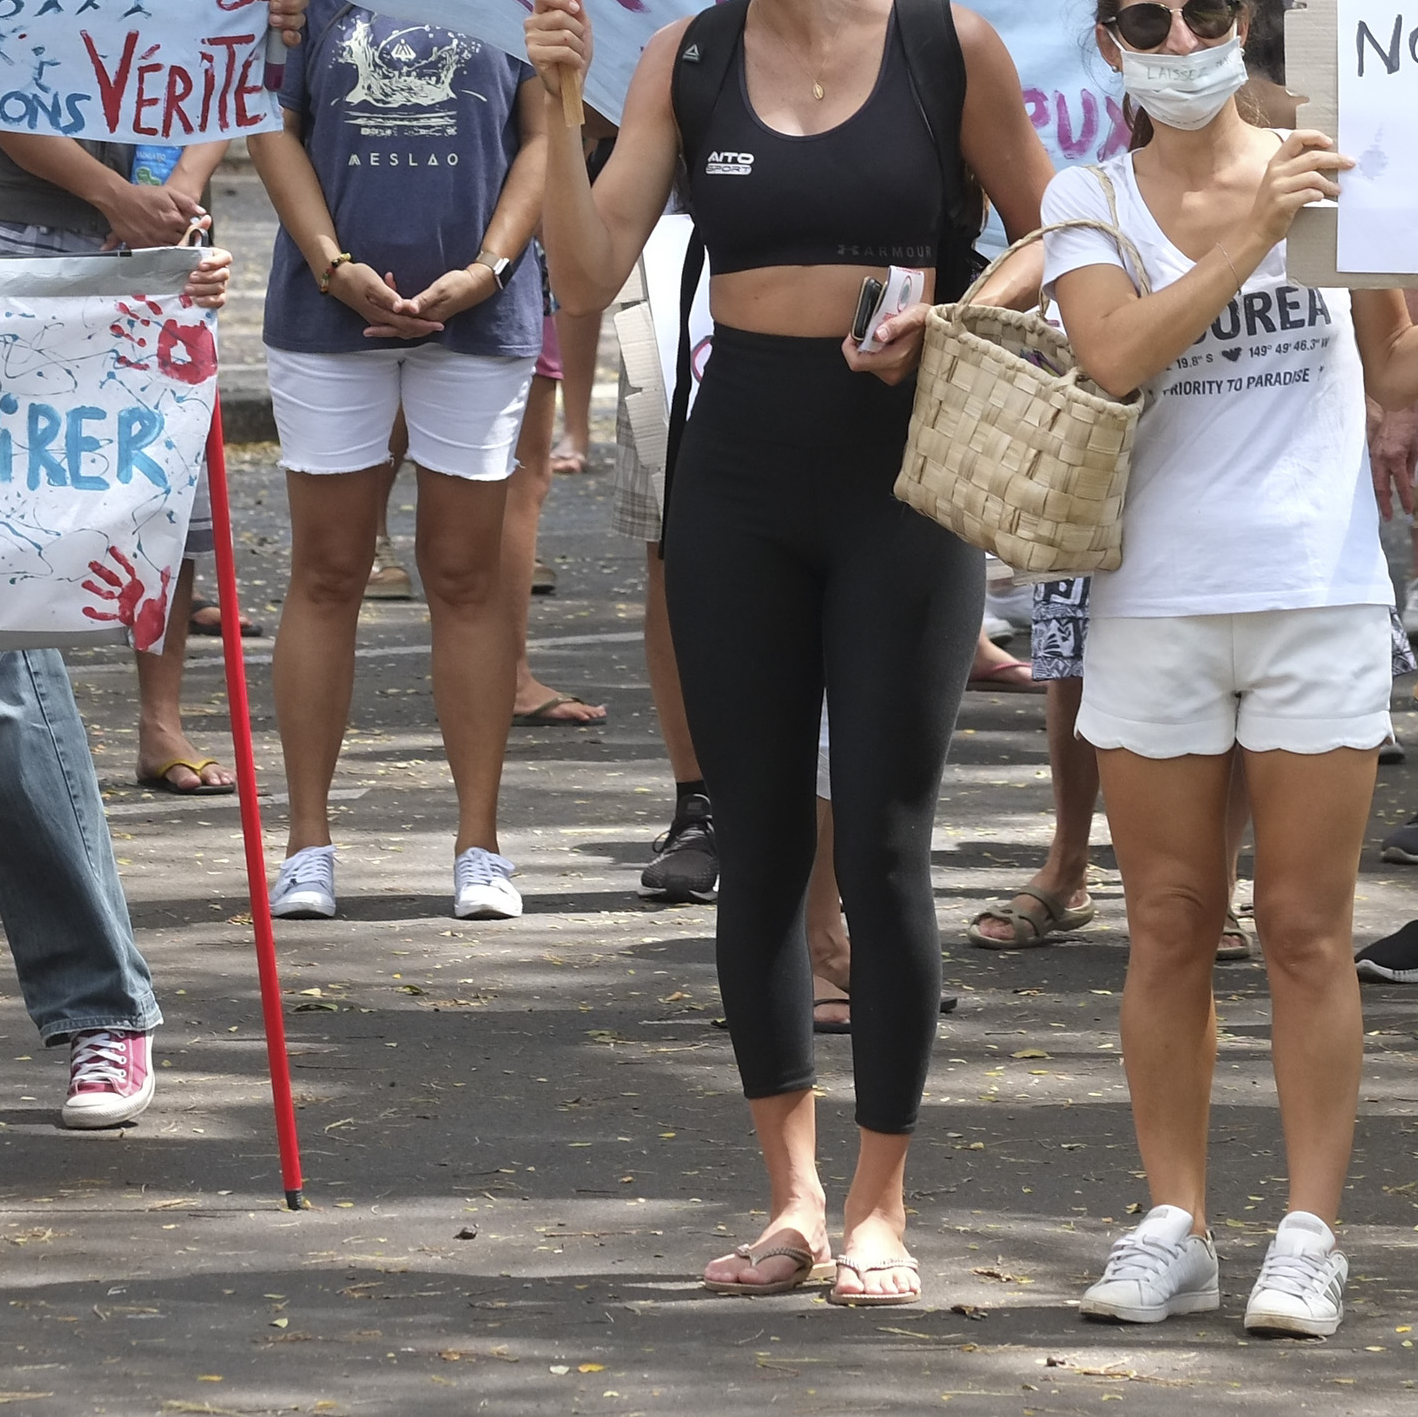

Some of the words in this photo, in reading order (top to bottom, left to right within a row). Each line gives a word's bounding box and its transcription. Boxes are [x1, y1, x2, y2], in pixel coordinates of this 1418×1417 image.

[708, 151, 755, 164] AITO
[706, 164, 752, 175] SPORT
[863, 245, 932, 259] ARMOUR
[1227, 378, 1243, 393] TO
[1246, 368, 1311, 390] PARADISE
